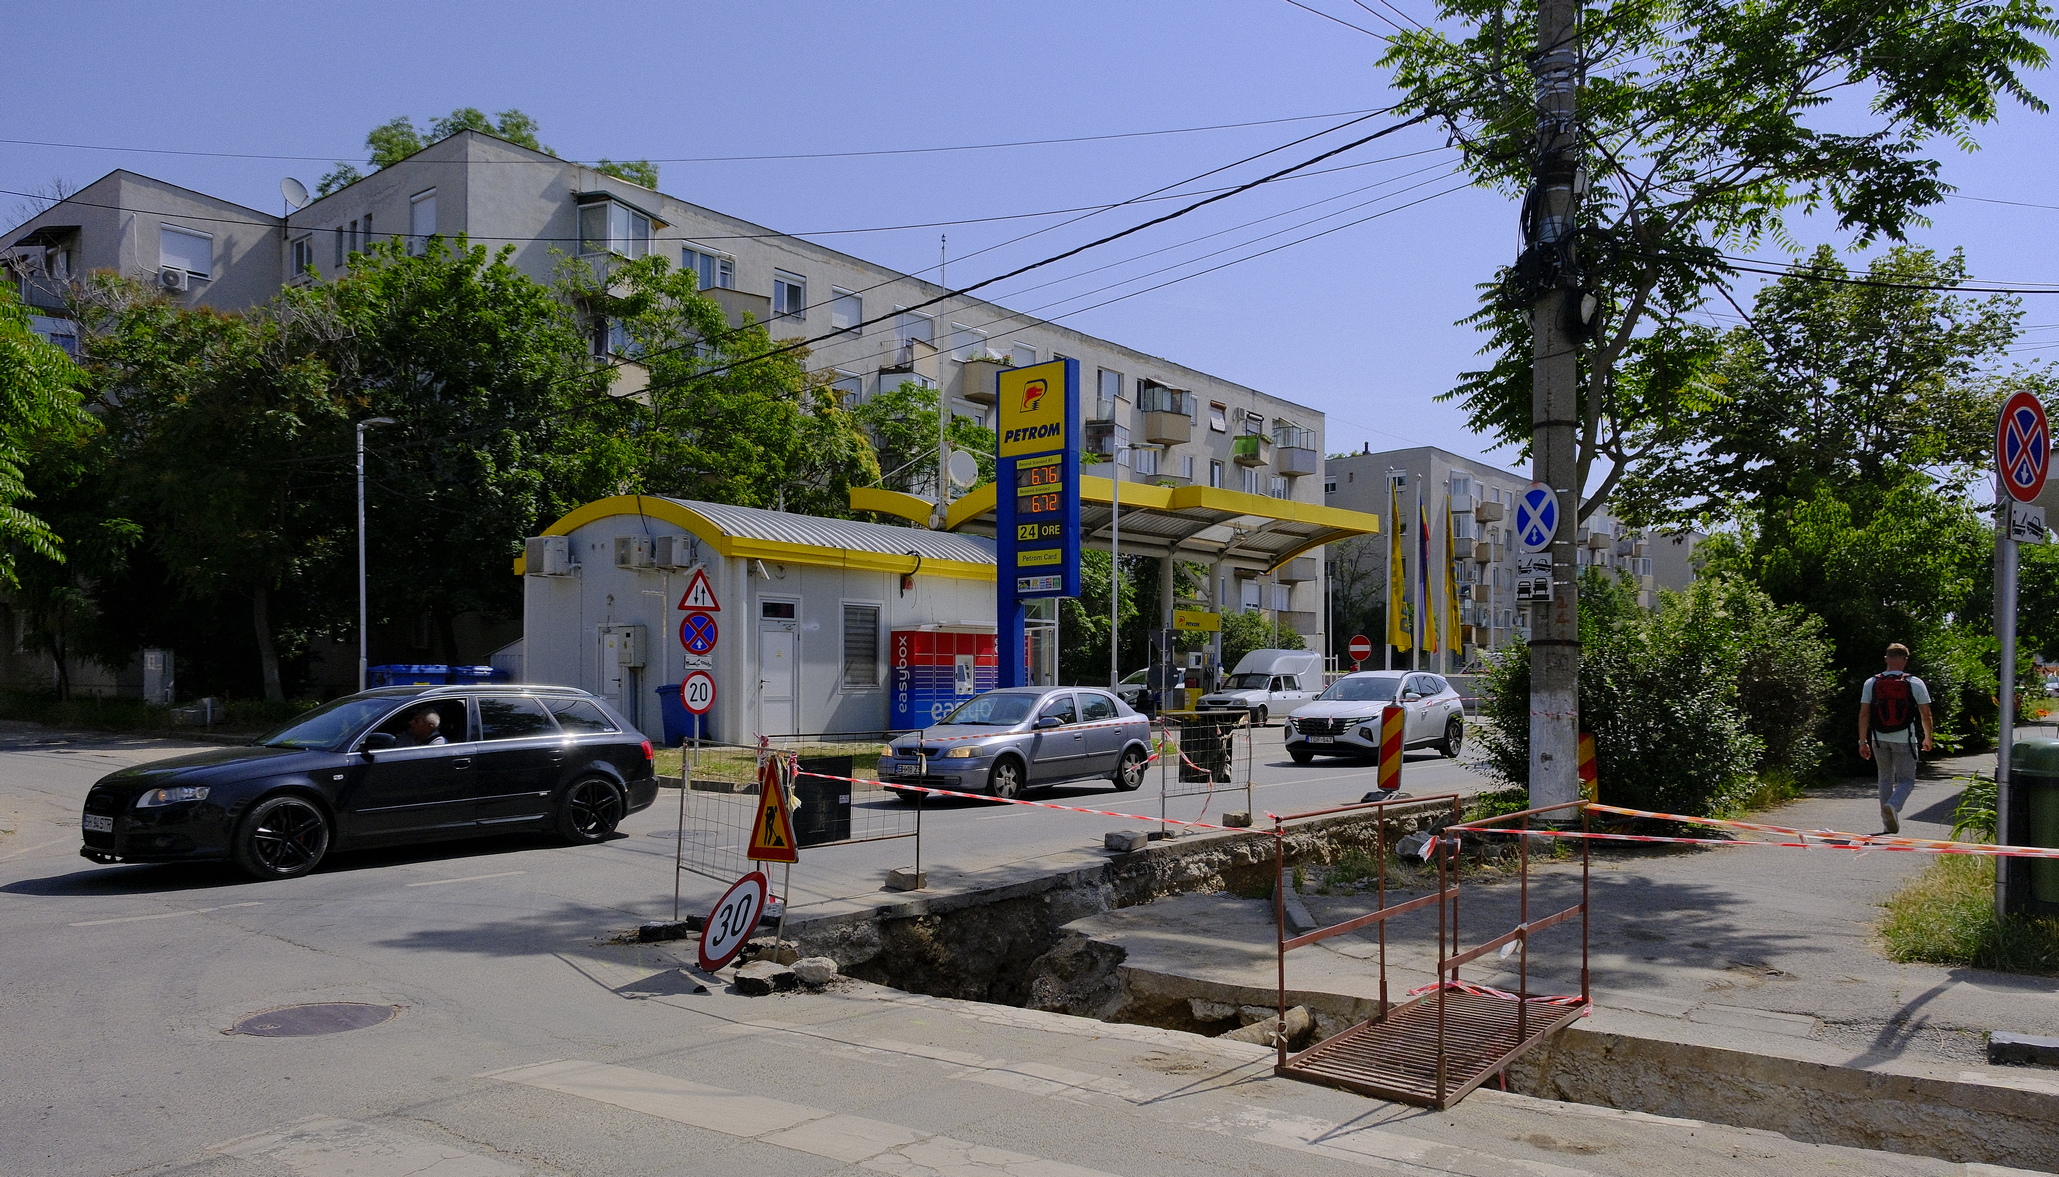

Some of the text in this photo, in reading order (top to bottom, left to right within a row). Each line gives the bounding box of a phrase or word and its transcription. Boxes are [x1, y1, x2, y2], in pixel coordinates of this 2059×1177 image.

[1003, 422, 1060, 444] PETROM
[1032, 466, 1057, 485] 6.76
[1032, 494, 1057, 513] 6.72
[1020, 524, 1061, 539] 24 ORE
[896, 635, 910, 713] easybox
[689, 682, 708, 702] 20
[712, 893, 753, 947] 30
